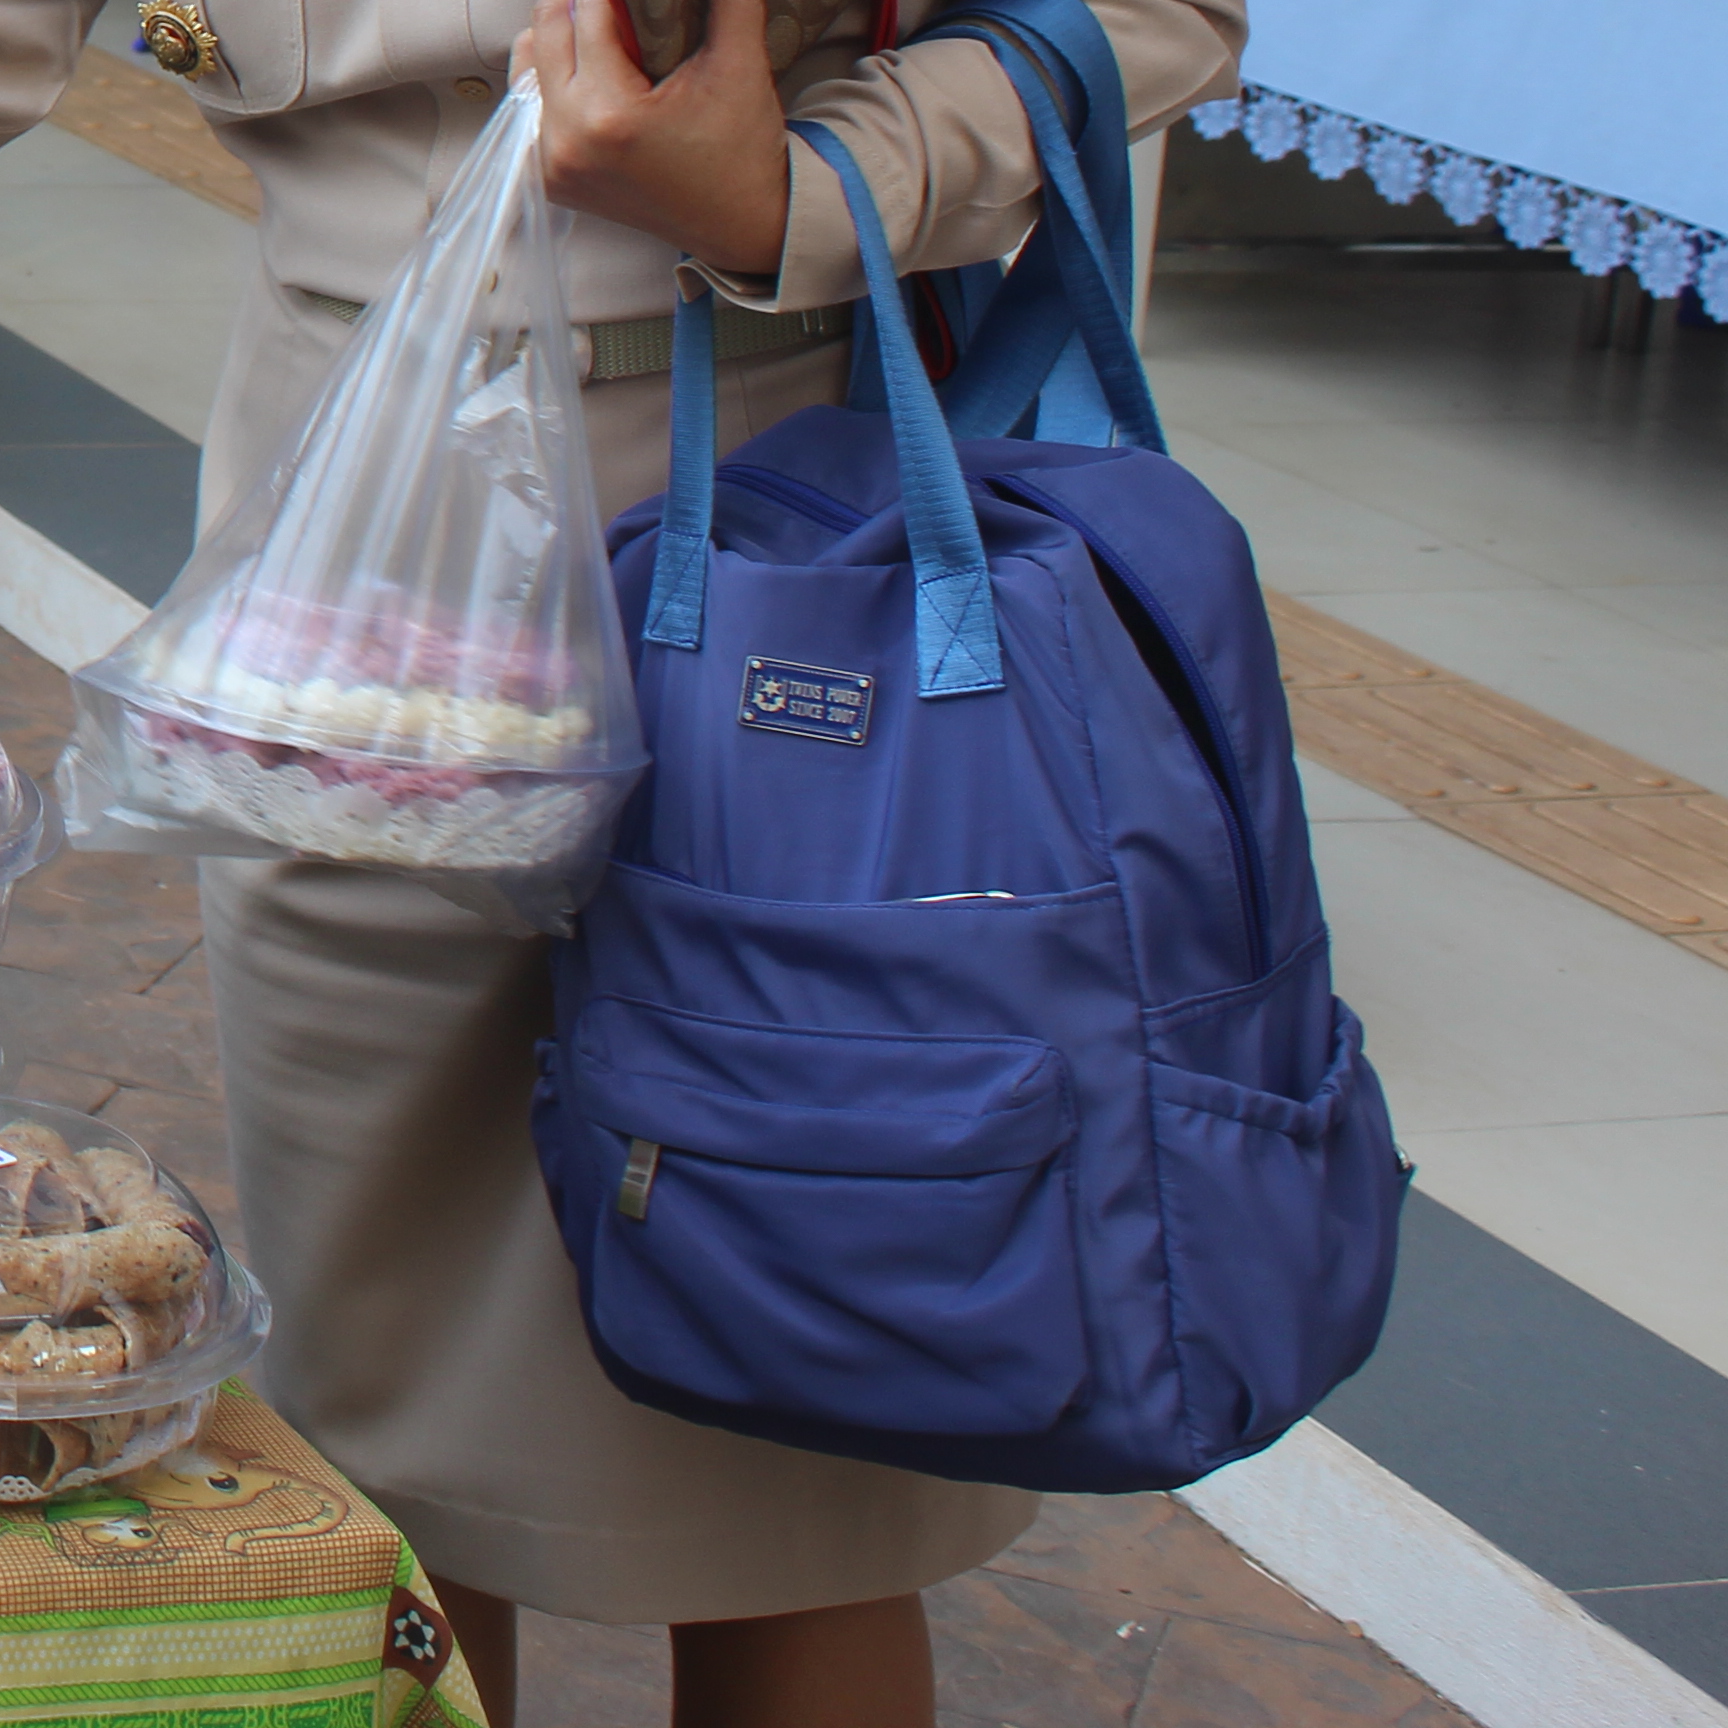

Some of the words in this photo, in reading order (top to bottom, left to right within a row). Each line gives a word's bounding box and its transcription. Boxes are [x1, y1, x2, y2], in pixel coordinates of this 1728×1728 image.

[788, 680, 824, 700] TWINS
[826, 686, 862, 707] POWER
[788, 700, 825, 720] SINCE
